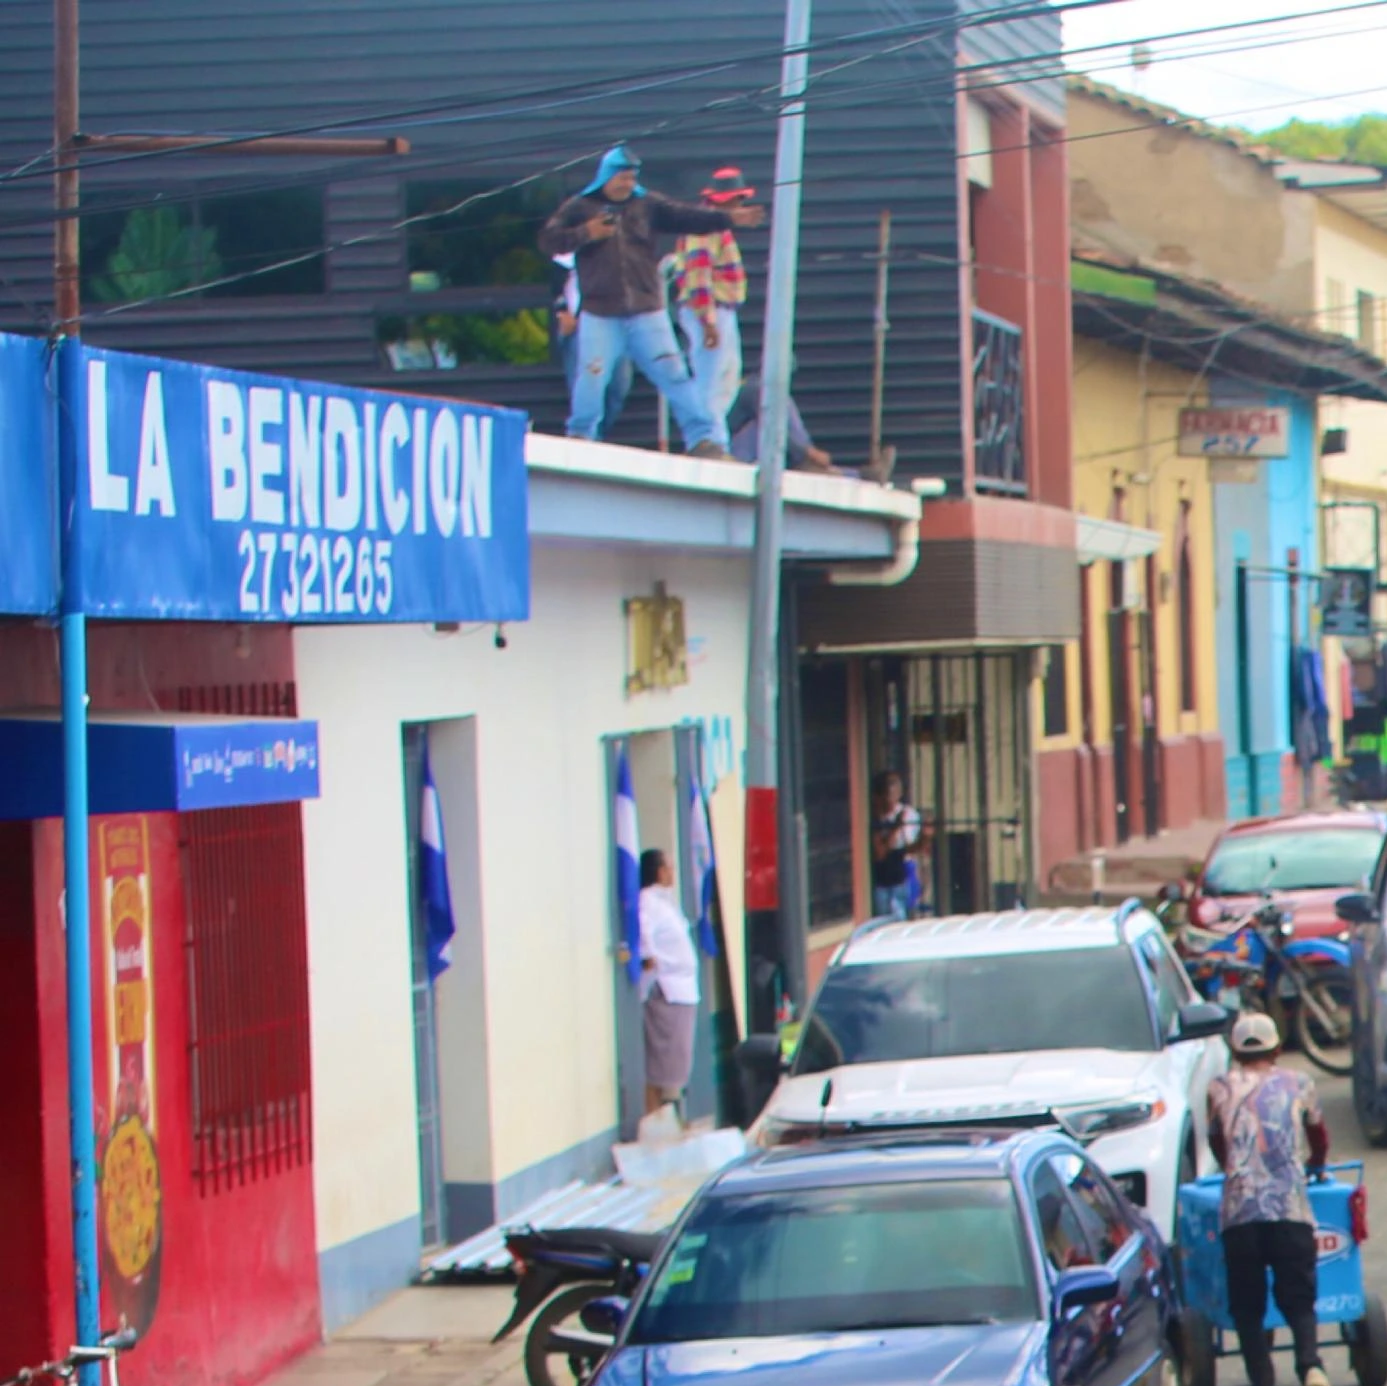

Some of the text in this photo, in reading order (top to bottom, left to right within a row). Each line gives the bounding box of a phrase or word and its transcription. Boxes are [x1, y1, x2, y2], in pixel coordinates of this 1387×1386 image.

[88, 360, 493, 538] LA BENDICION
[238, 529, 393, 616] 27321265
